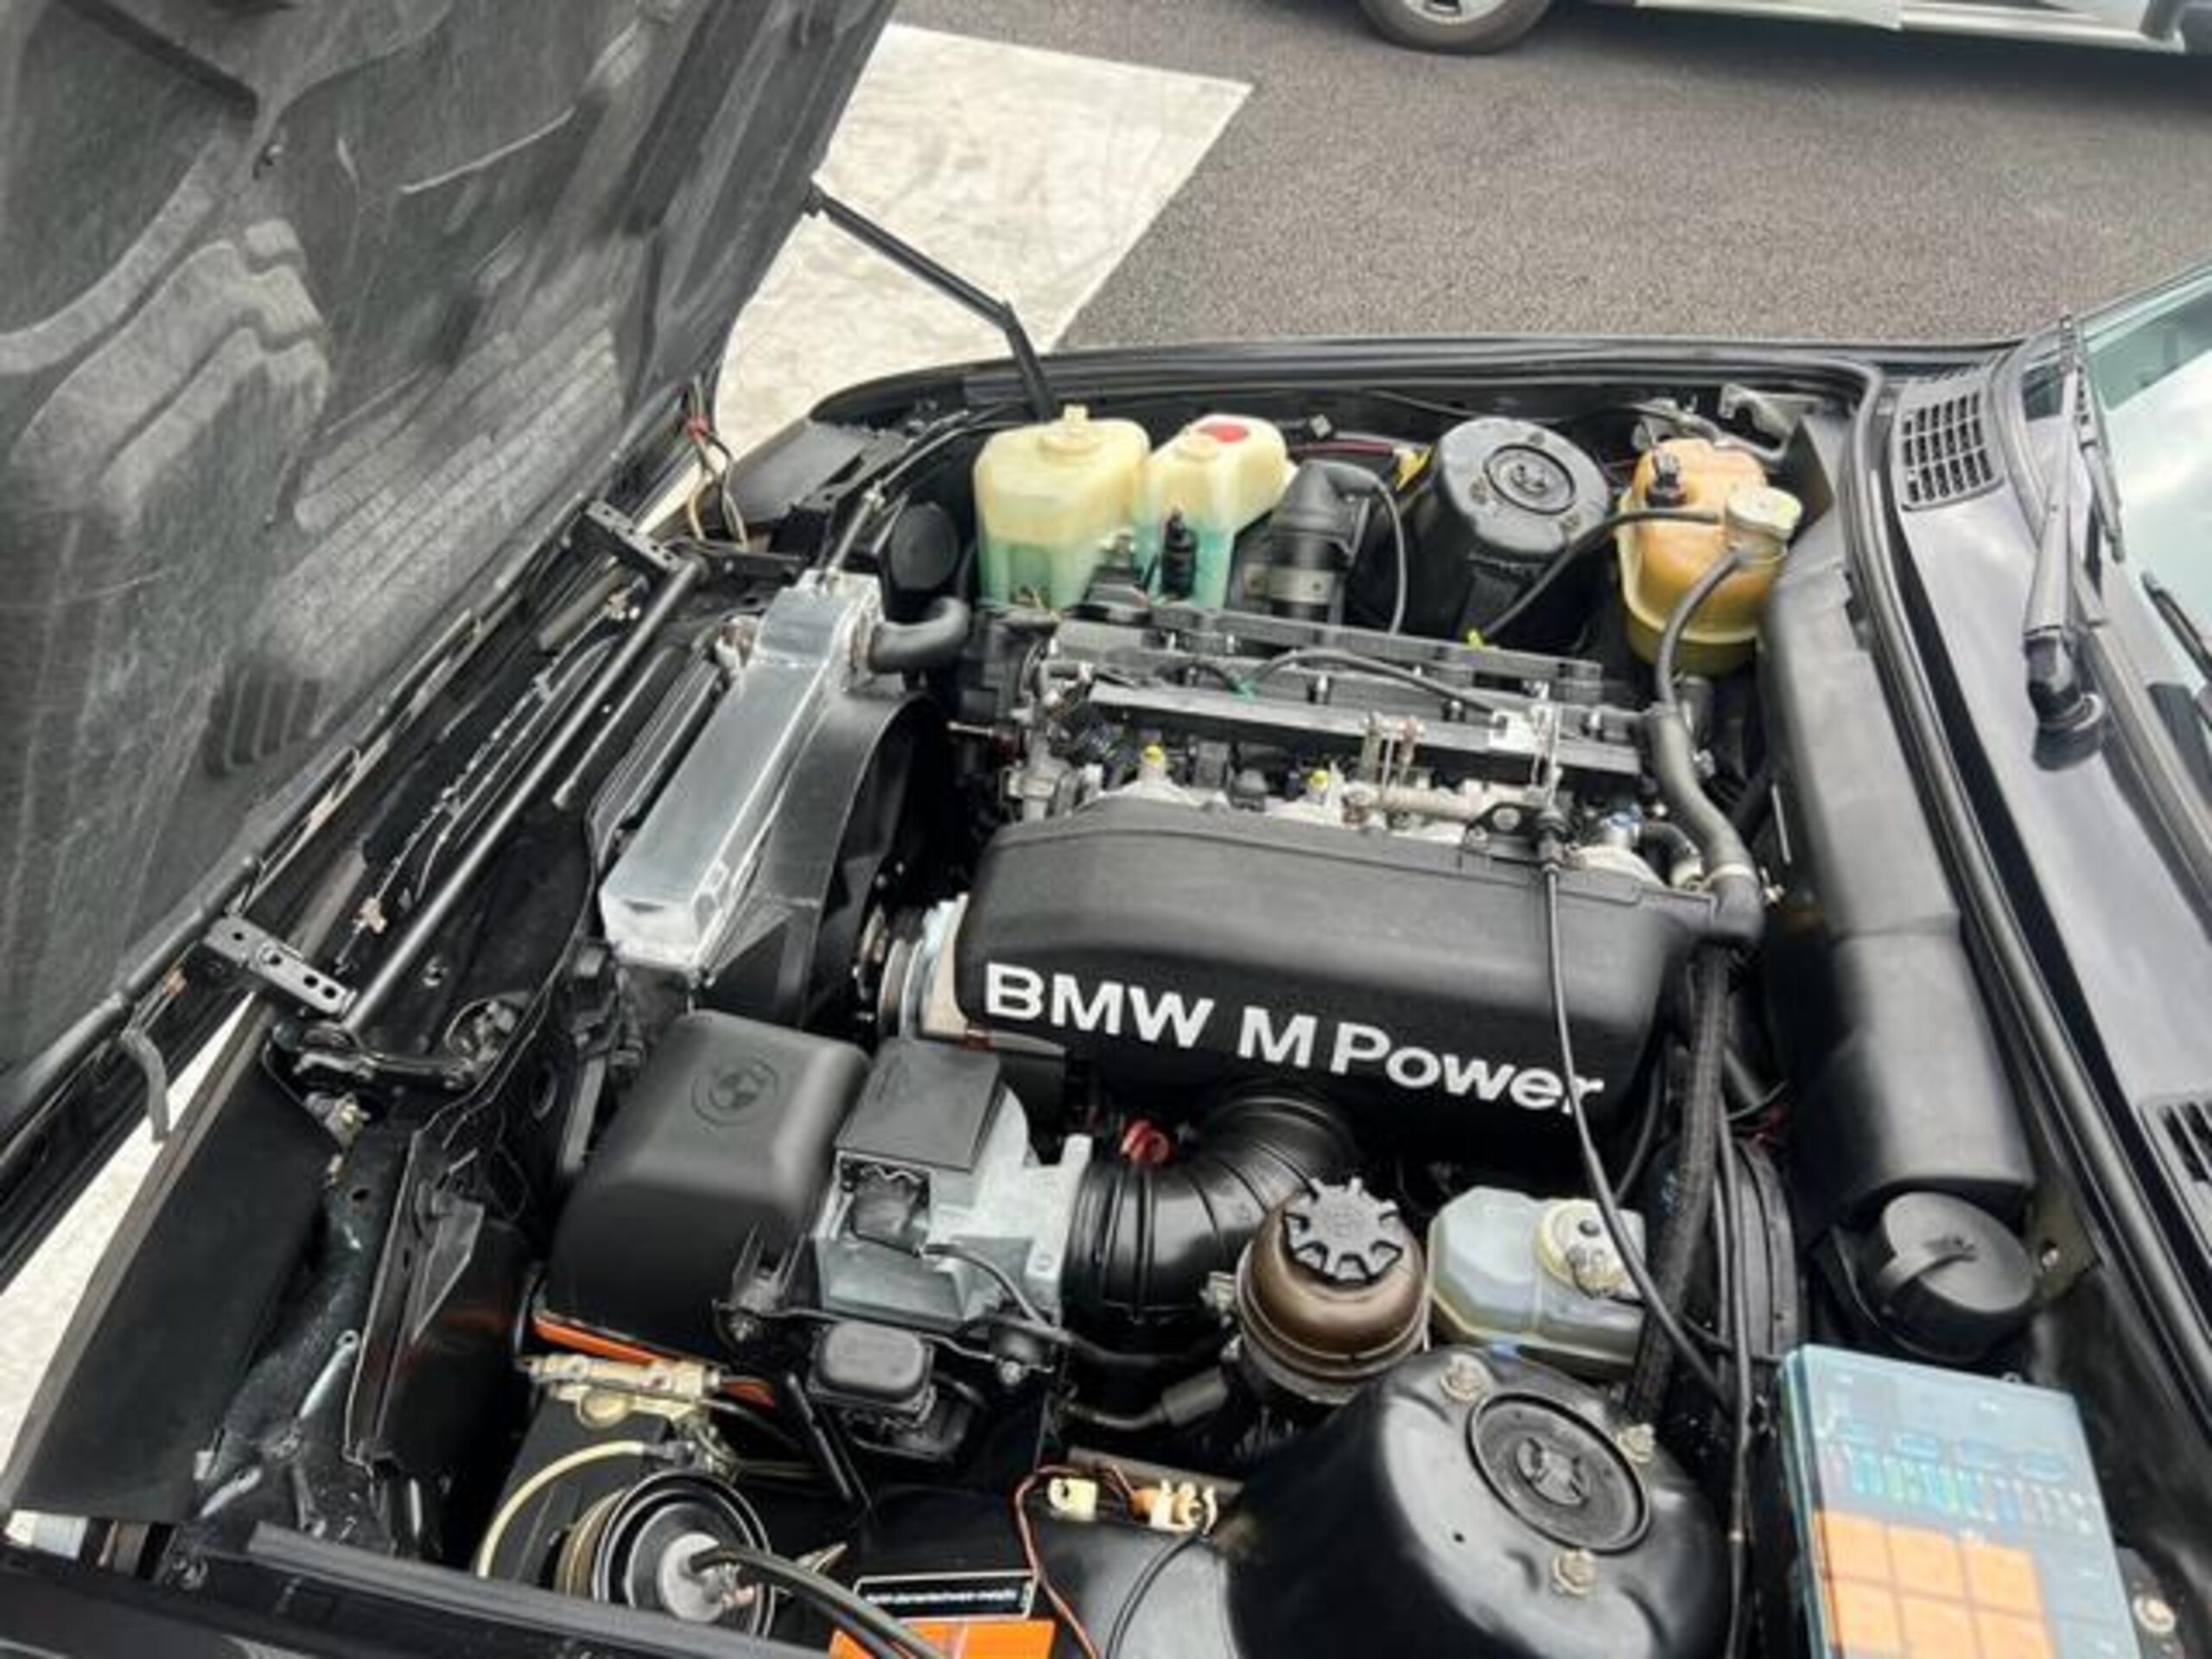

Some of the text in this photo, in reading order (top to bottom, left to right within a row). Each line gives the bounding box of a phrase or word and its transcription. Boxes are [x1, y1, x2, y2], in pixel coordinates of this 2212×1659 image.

[986, 961, 1605, 1115] BMW M Power
